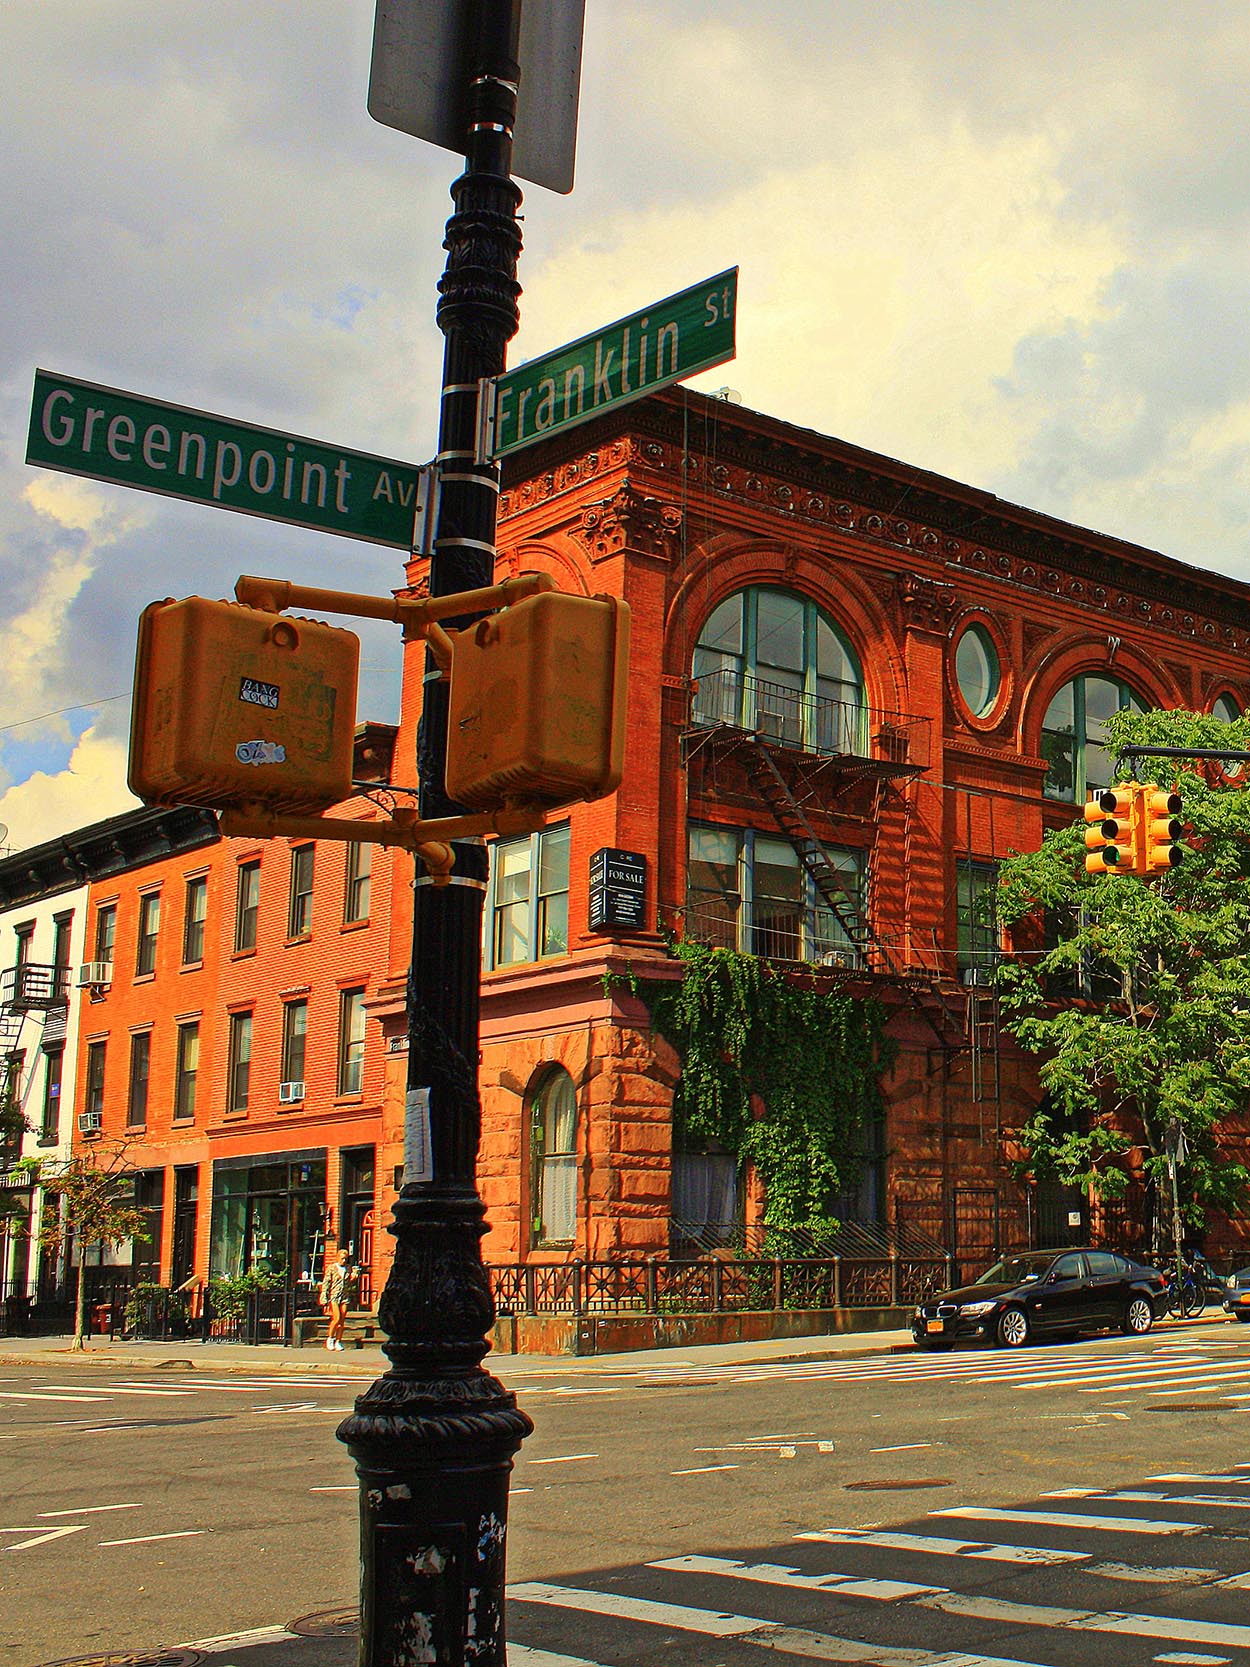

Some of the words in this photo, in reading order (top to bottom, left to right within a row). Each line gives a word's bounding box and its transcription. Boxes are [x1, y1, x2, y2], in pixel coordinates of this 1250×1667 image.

[496, 317, 679, 450] Franklin
[704, 286, 732, 327] St
[42, 389, 352, 513] Greenpoint
[372, 470, 417, 507] Av
[608, 869, 625, 881] FOR
[625, 872, 644, 885] SALE
